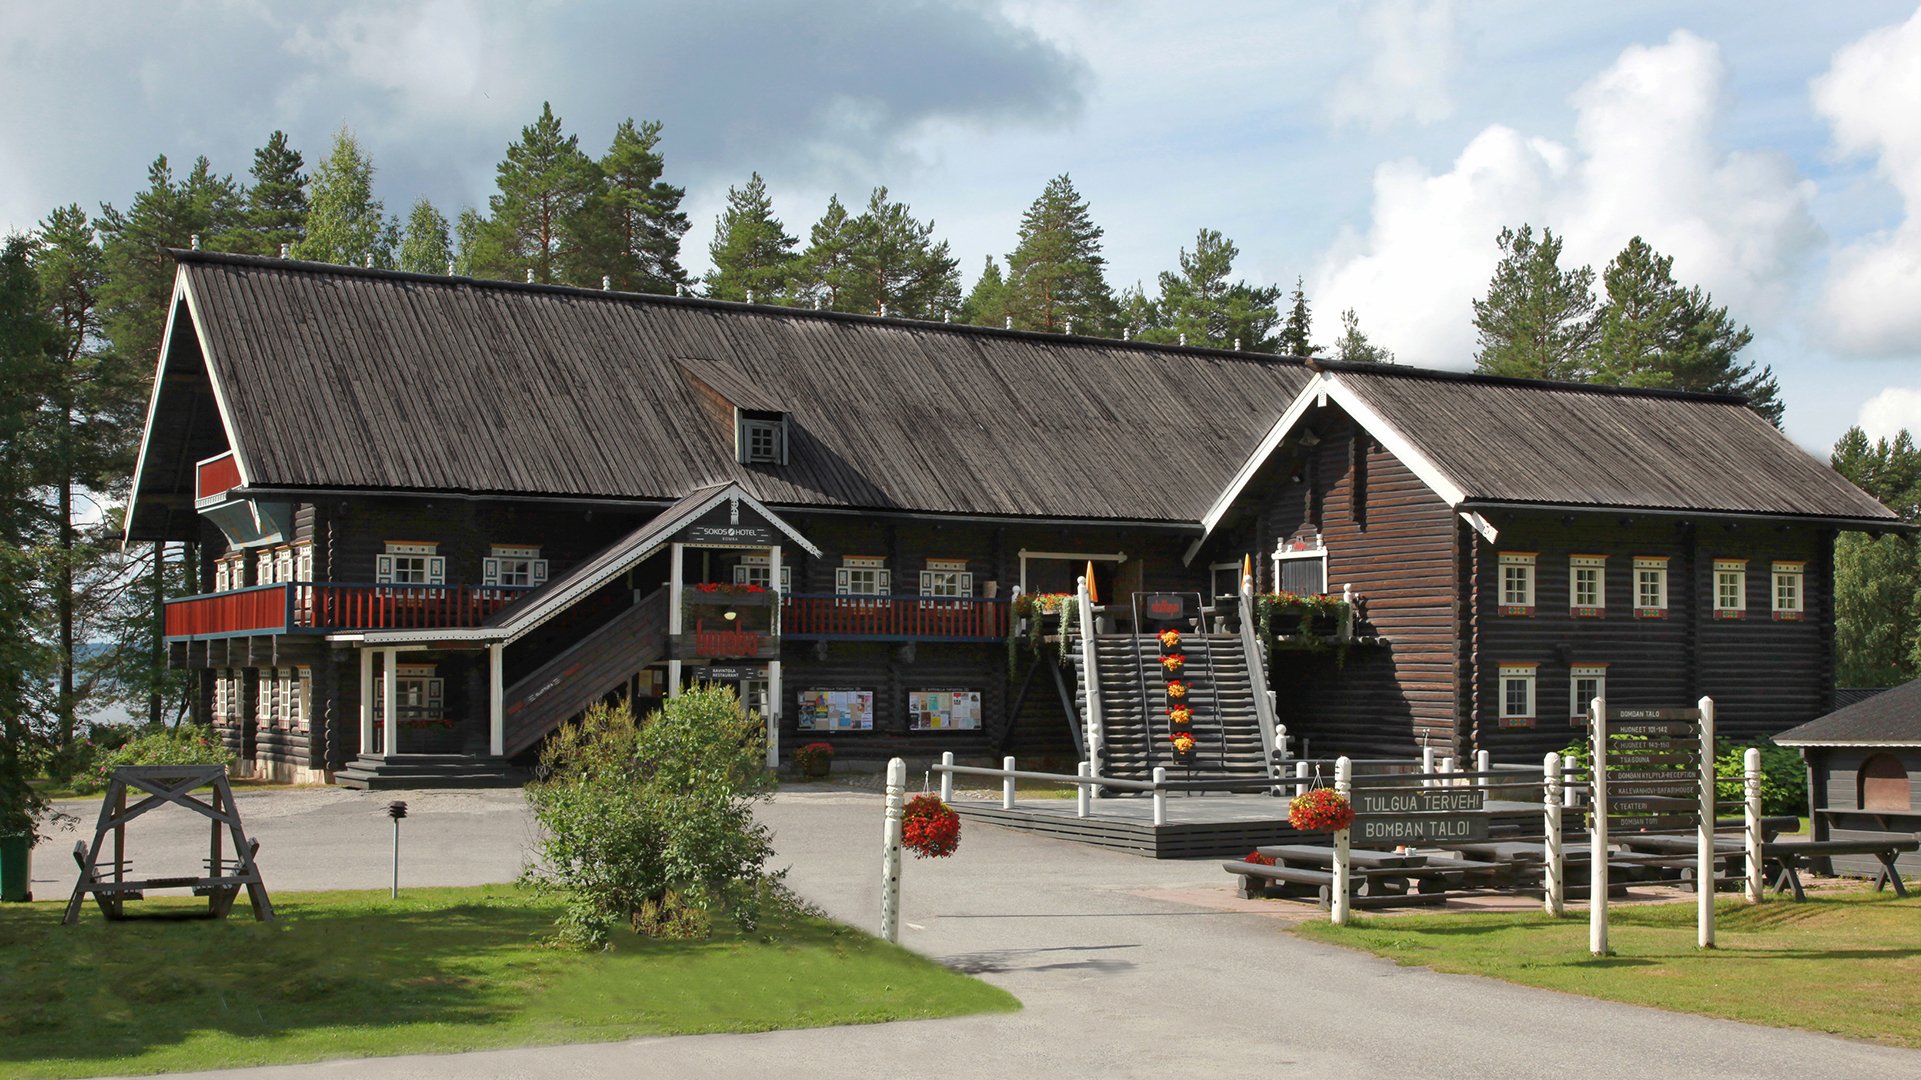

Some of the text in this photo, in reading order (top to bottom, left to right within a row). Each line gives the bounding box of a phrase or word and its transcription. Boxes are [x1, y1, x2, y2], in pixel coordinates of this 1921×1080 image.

[703, 528, 757, 537] SOKOS HOTEL
[695, 616, 758, 657] bomba
[1645, 710, 1660, 718] TALO
[1364, 796, 1418, 811] TULGUA
[1365, 821, 1470, 837] BOMBAN TALOI
